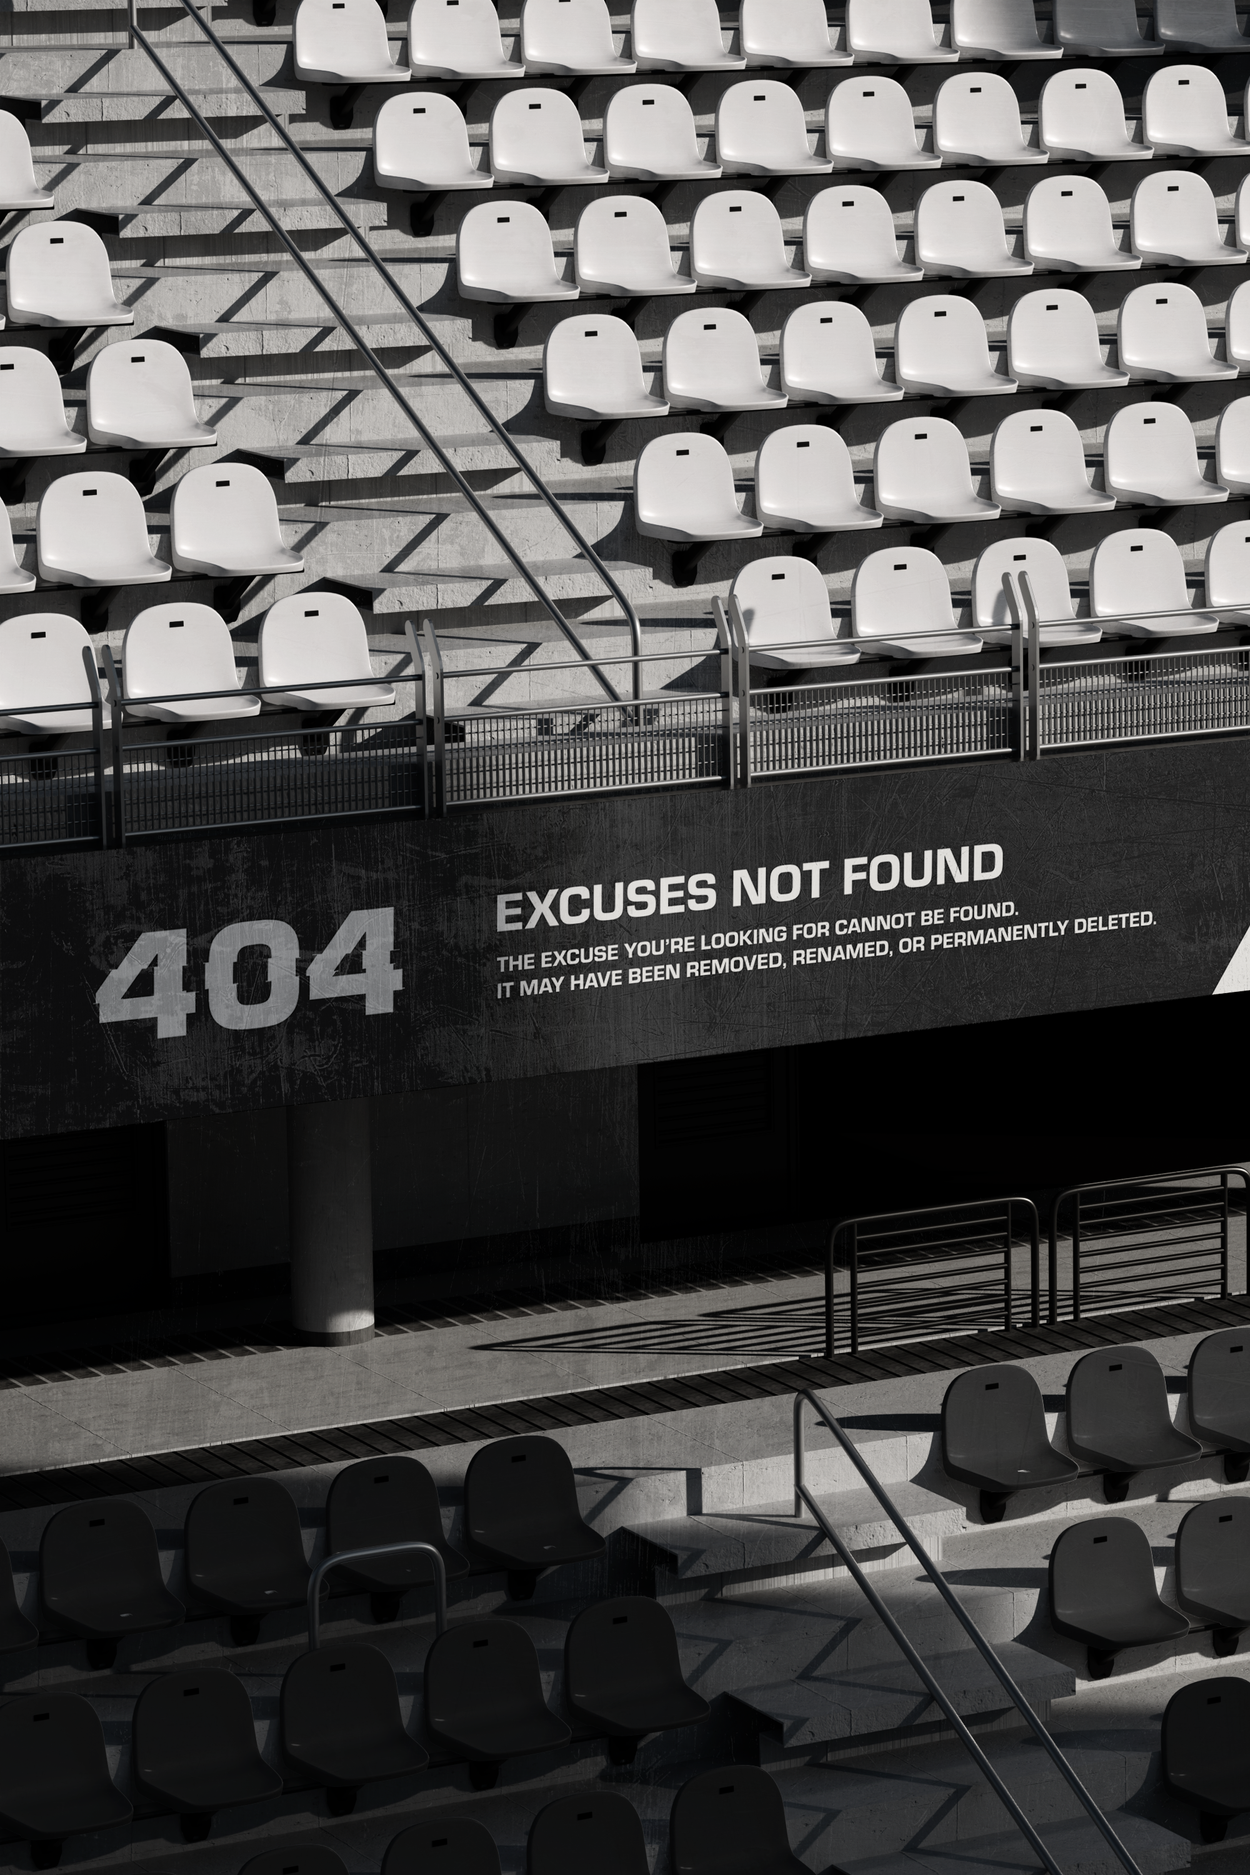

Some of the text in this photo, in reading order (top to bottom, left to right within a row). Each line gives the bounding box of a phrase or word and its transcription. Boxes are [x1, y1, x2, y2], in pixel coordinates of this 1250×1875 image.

[496, 843, 1004, 932] EXCUSES NOT FOUND
[95, 906, 404, 1040] 404
[496, 901, 1020, 973] THE EXCUSE YOU’RE LOOKING FOR CANNOT BE FOUND.
[497, 910, 1158, 999] IT MAY HAVE BEEN REMOVED, RENAMED, OR PERMANENTLY DELETED.
